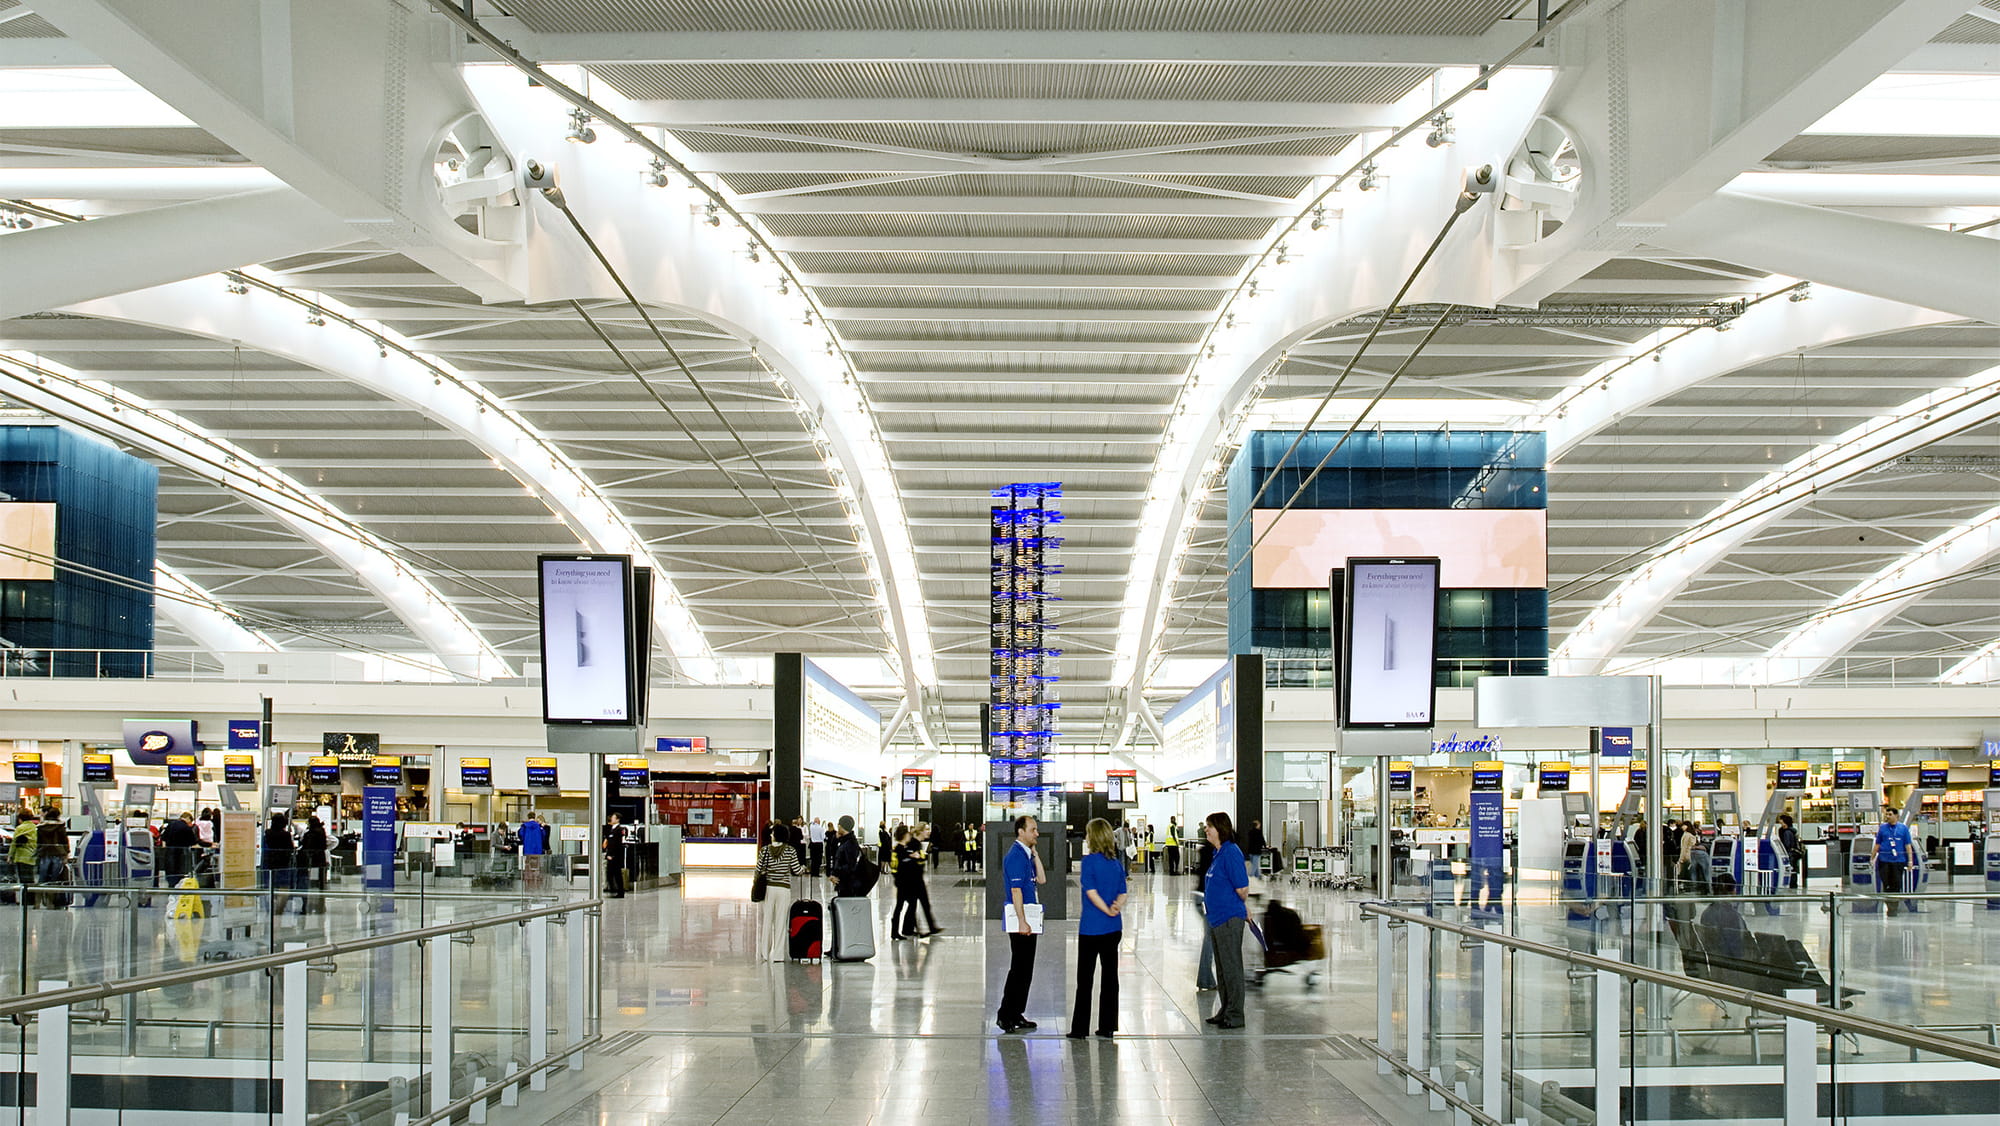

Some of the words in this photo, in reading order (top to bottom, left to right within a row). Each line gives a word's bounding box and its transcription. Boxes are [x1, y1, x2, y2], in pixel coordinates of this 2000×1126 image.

[555, 569, 585, 577] Everything
[596, 569, 610, 577] need
[1367, 572, 1396, 581] Everything
